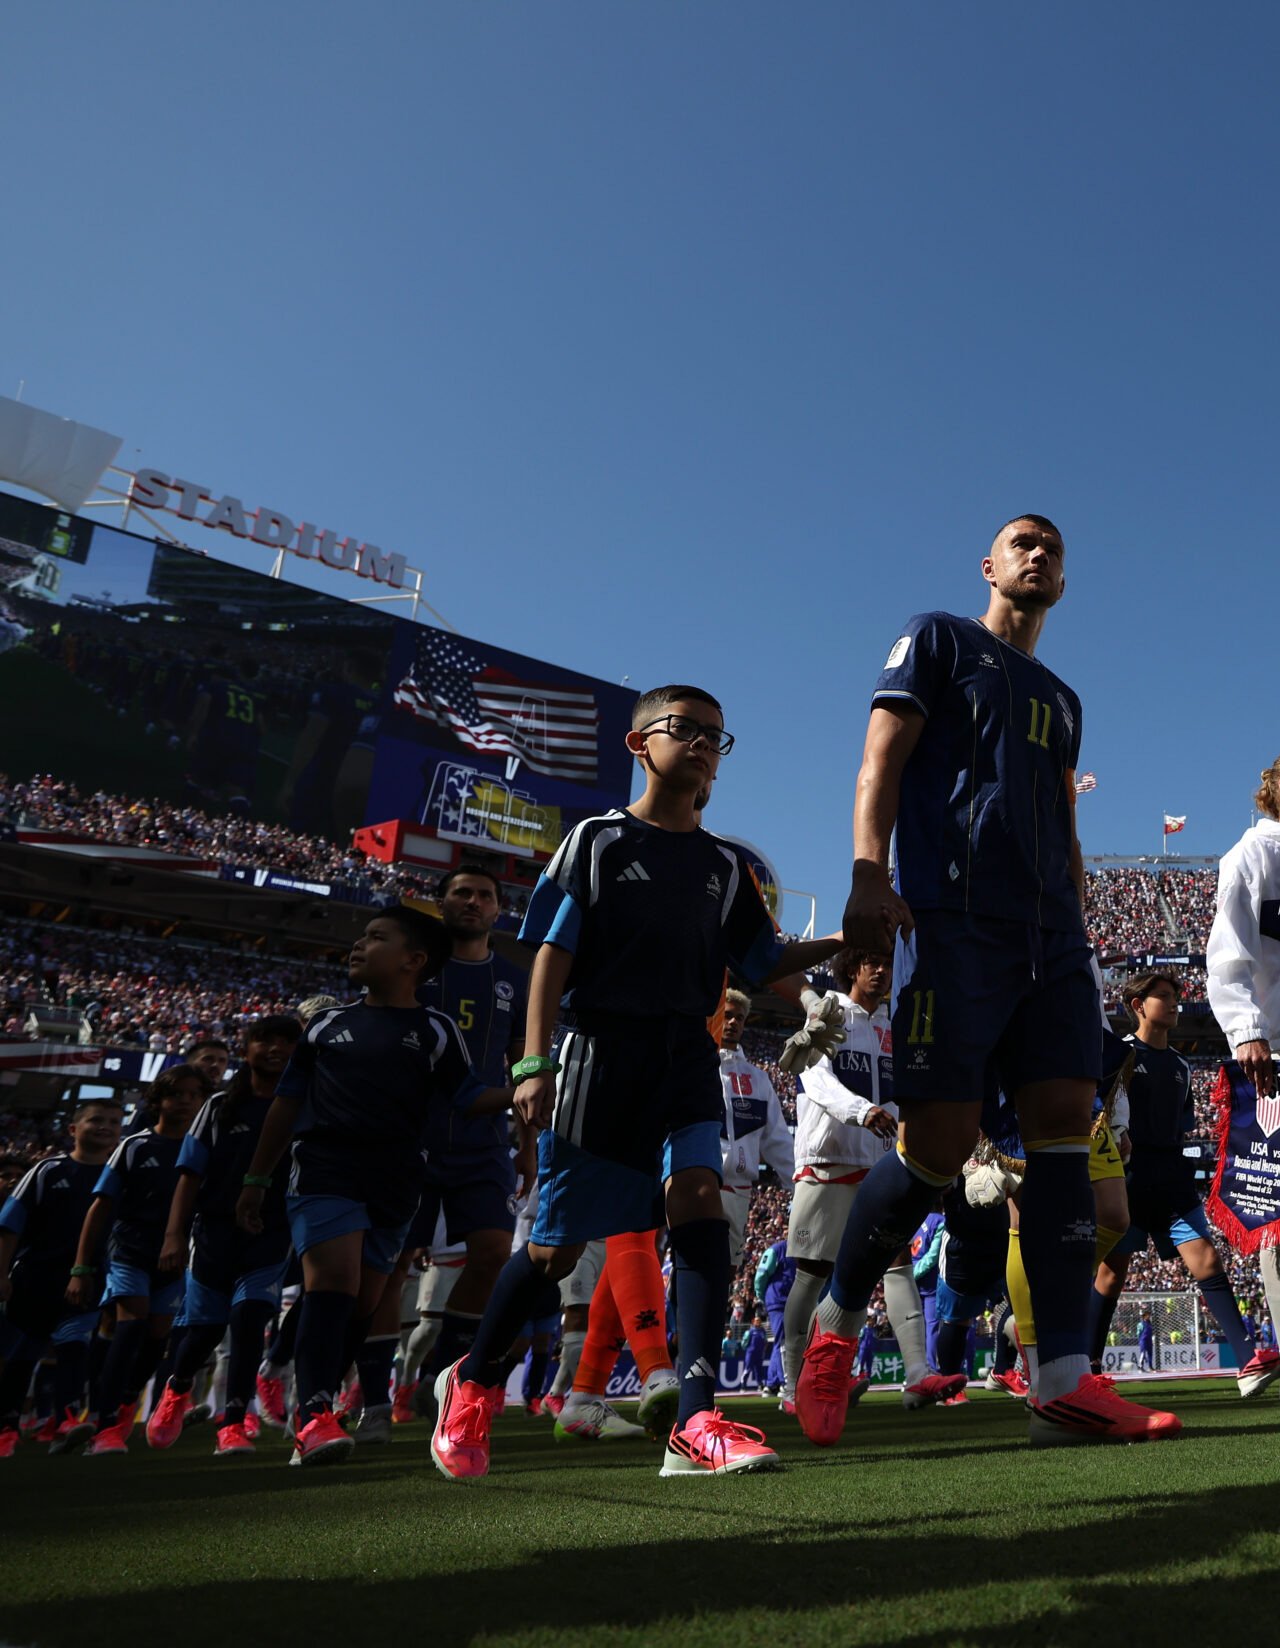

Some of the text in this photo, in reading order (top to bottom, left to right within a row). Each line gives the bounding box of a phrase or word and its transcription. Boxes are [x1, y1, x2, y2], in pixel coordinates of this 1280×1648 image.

[131, 468, 408, 589] STADIUM
[1027, 697, 1051, 748] 11
[504, 755, 520, 780] V
[254, 868, 270, 888] V
[457, 999, 475, 1031] 5
[906, 990, 935, 1044] 11
[839, 1051, 871, 1074] USA
[1250, 1141, 1269, 1157] USA
[1234, 1155, 1251, 1170] Bosnia
[1251, 1157, 1262, 1171] and
[1235, 1172, 1247, 1182] FIFA
[1247, 1174, 1262, 1185] World
[1263, 1176, 1274, 1187] Cup
[1246, 1183, 1261, 1192] Round
[1106, 1352, 1125, 1366] OF
